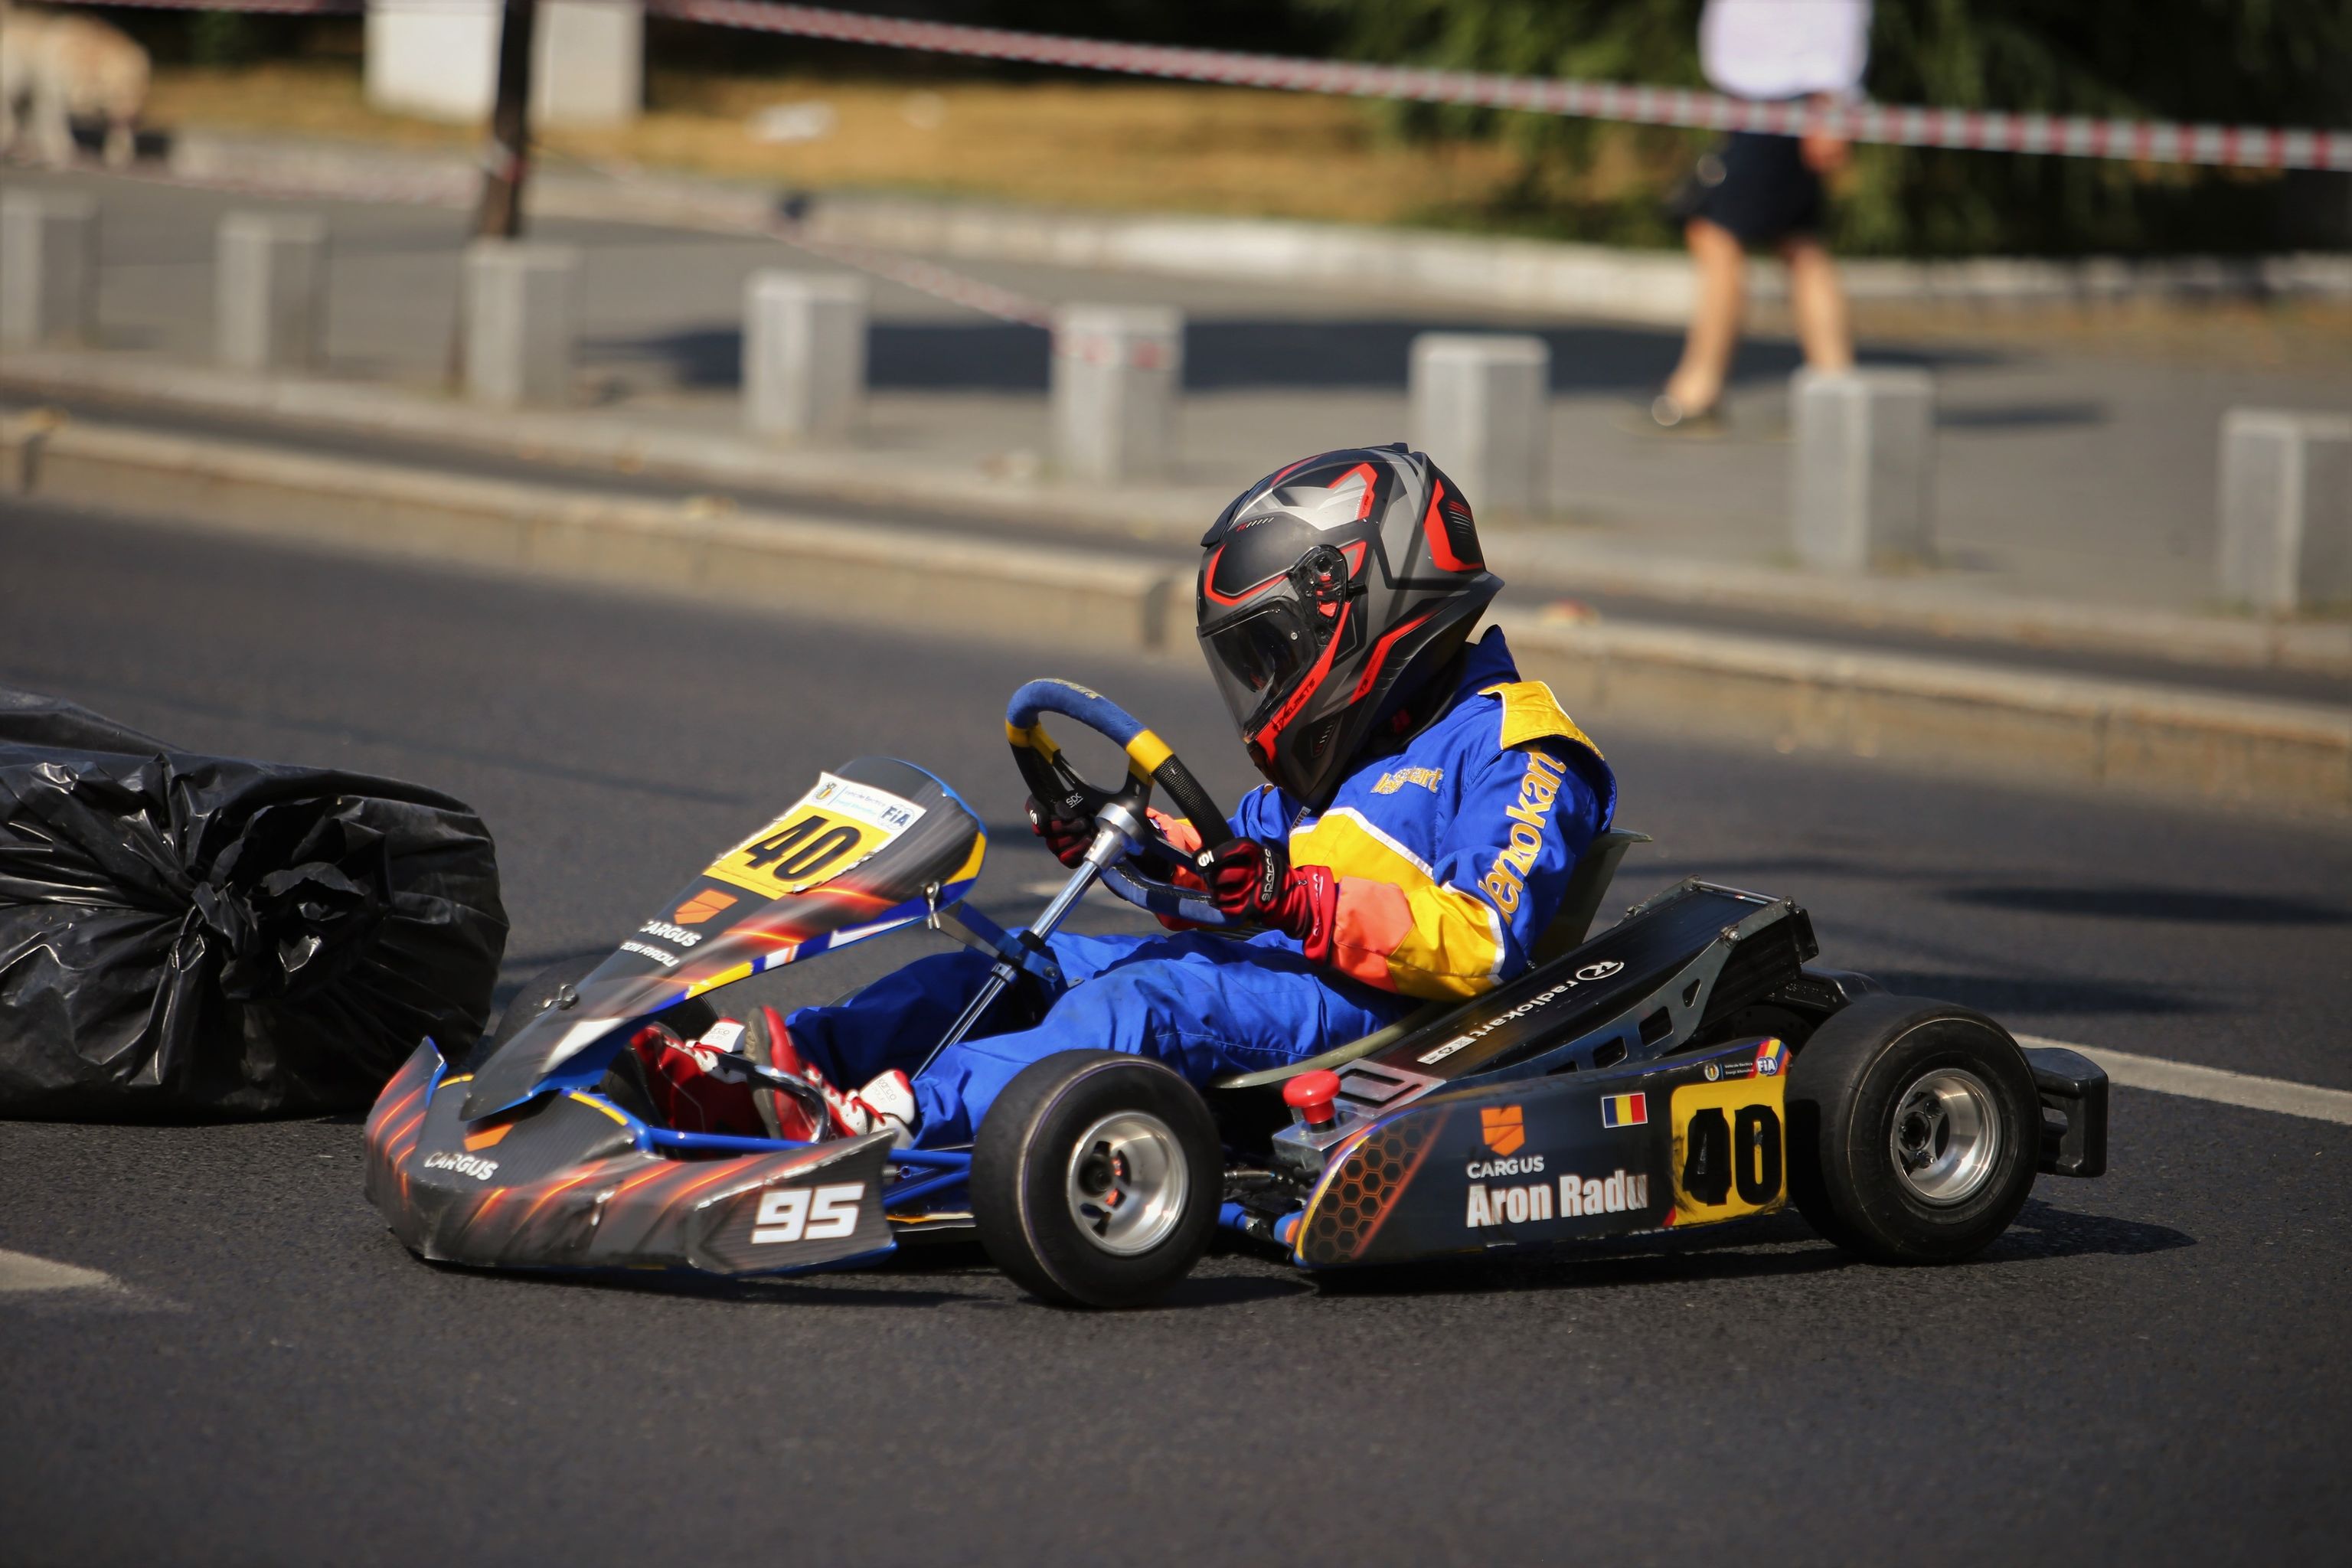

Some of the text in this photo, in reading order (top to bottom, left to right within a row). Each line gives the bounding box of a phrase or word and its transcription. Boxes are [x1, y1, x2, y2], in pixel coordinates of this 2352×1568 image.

[744, 815, 861, 881] 40
[424, 1152, 499, 1181] CARGUS
[1467, 1155, 1544, 1180] CARGUS
[1682, 1104, 1783, 1207] 40
[751, 1182, 865, 1244] 95
[1467, 1170, 1648, 1228] Aron Radu
